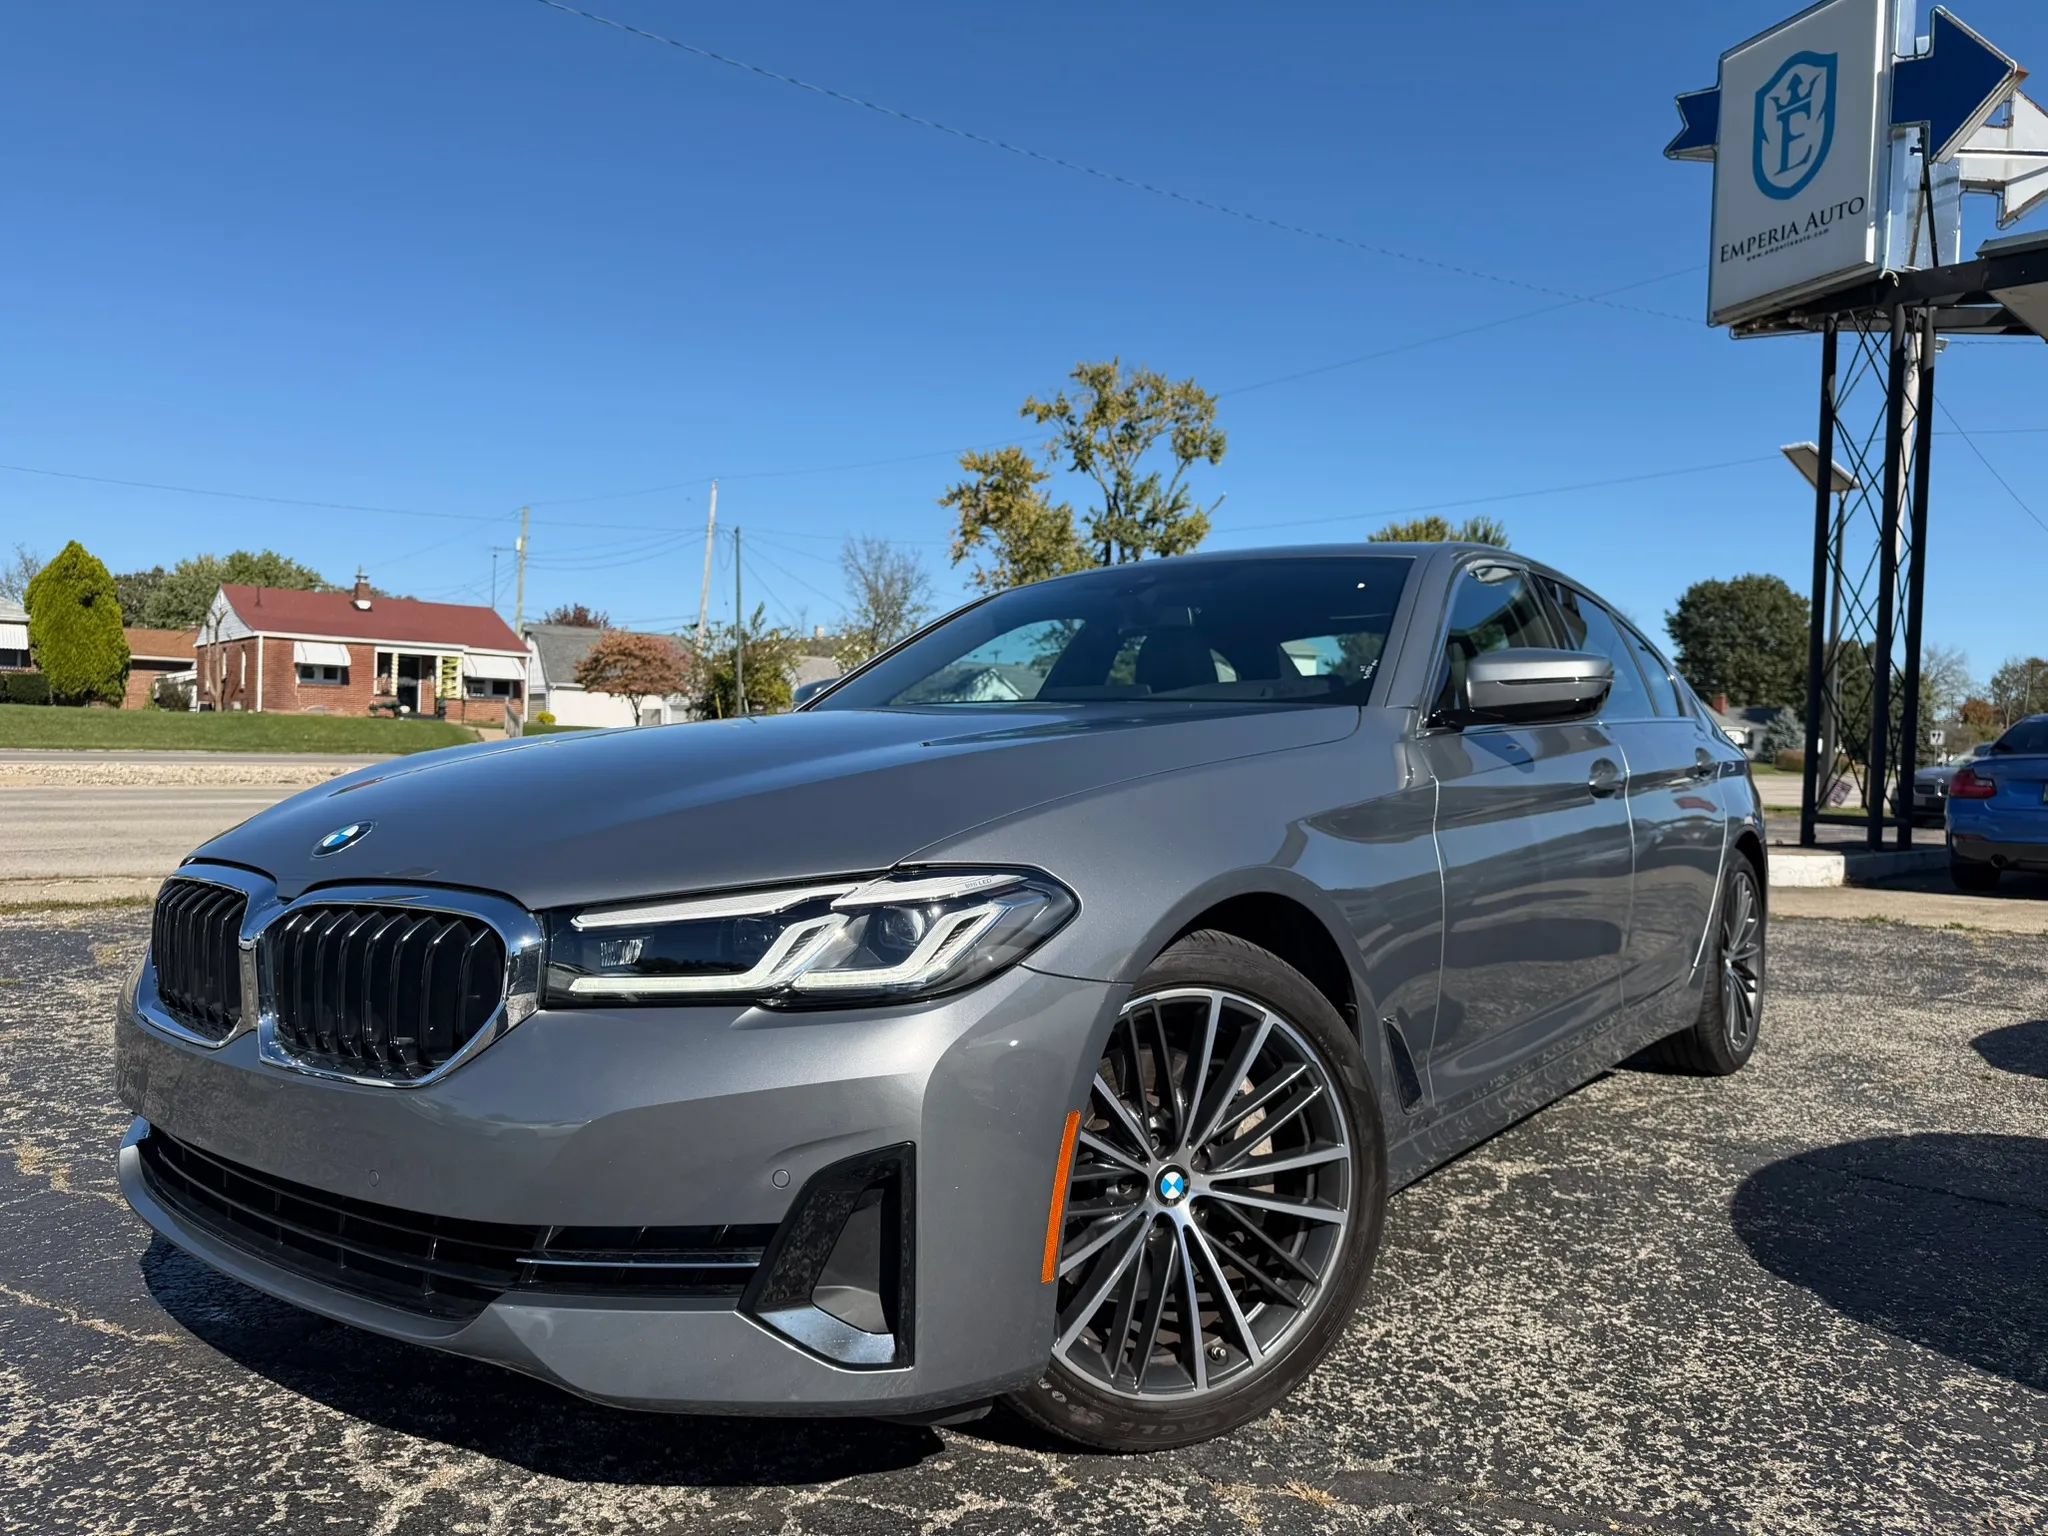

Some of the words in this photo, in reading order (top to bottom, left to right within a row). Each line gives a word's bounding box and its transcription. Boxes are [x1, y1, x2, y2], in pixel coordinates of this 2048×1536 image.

[1774, 99, 1812, 176] E
[1720, 221, 1800, 264] EMPERIA
[1804, 196, 1866, 233] AUTO
